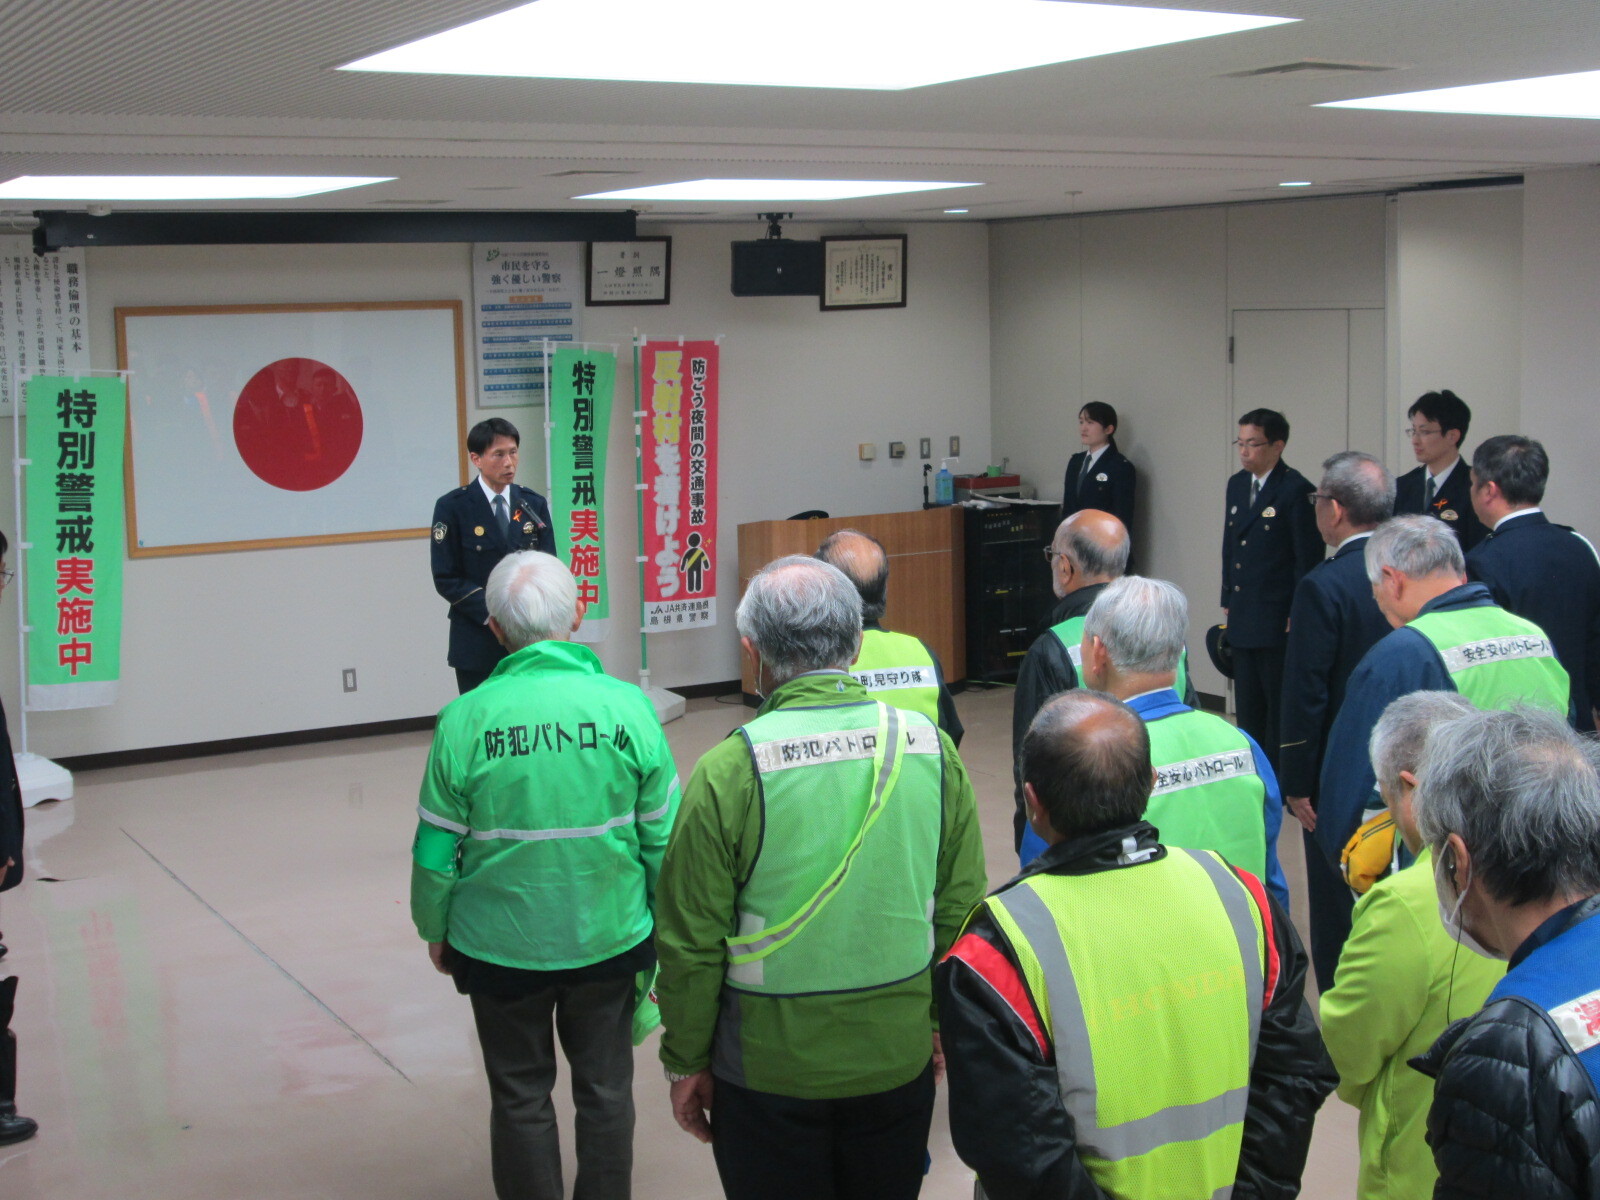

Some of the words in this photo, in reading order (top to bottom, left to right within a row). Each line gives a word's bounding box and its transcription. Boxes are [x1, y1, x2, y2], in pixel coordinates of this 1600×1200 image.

[491, 273, 561, 285] 強く優しい警察
[501, 260, 550, 271] 市民を守る
[66, 263, 82, 353] 職務倫理の基本
[690, 358, 707, 526] 防ごう夜間の交通事故
[570, 360, 600, 613] 特別警戒実施中
[55, 388, 97, 677] 特別警戒実施中
[650, 611, 709, 625] 島根県警察
[484, 722, 631, 760] 防犯パトロール
[781, 731, 916, 762] 防犯パトロル
